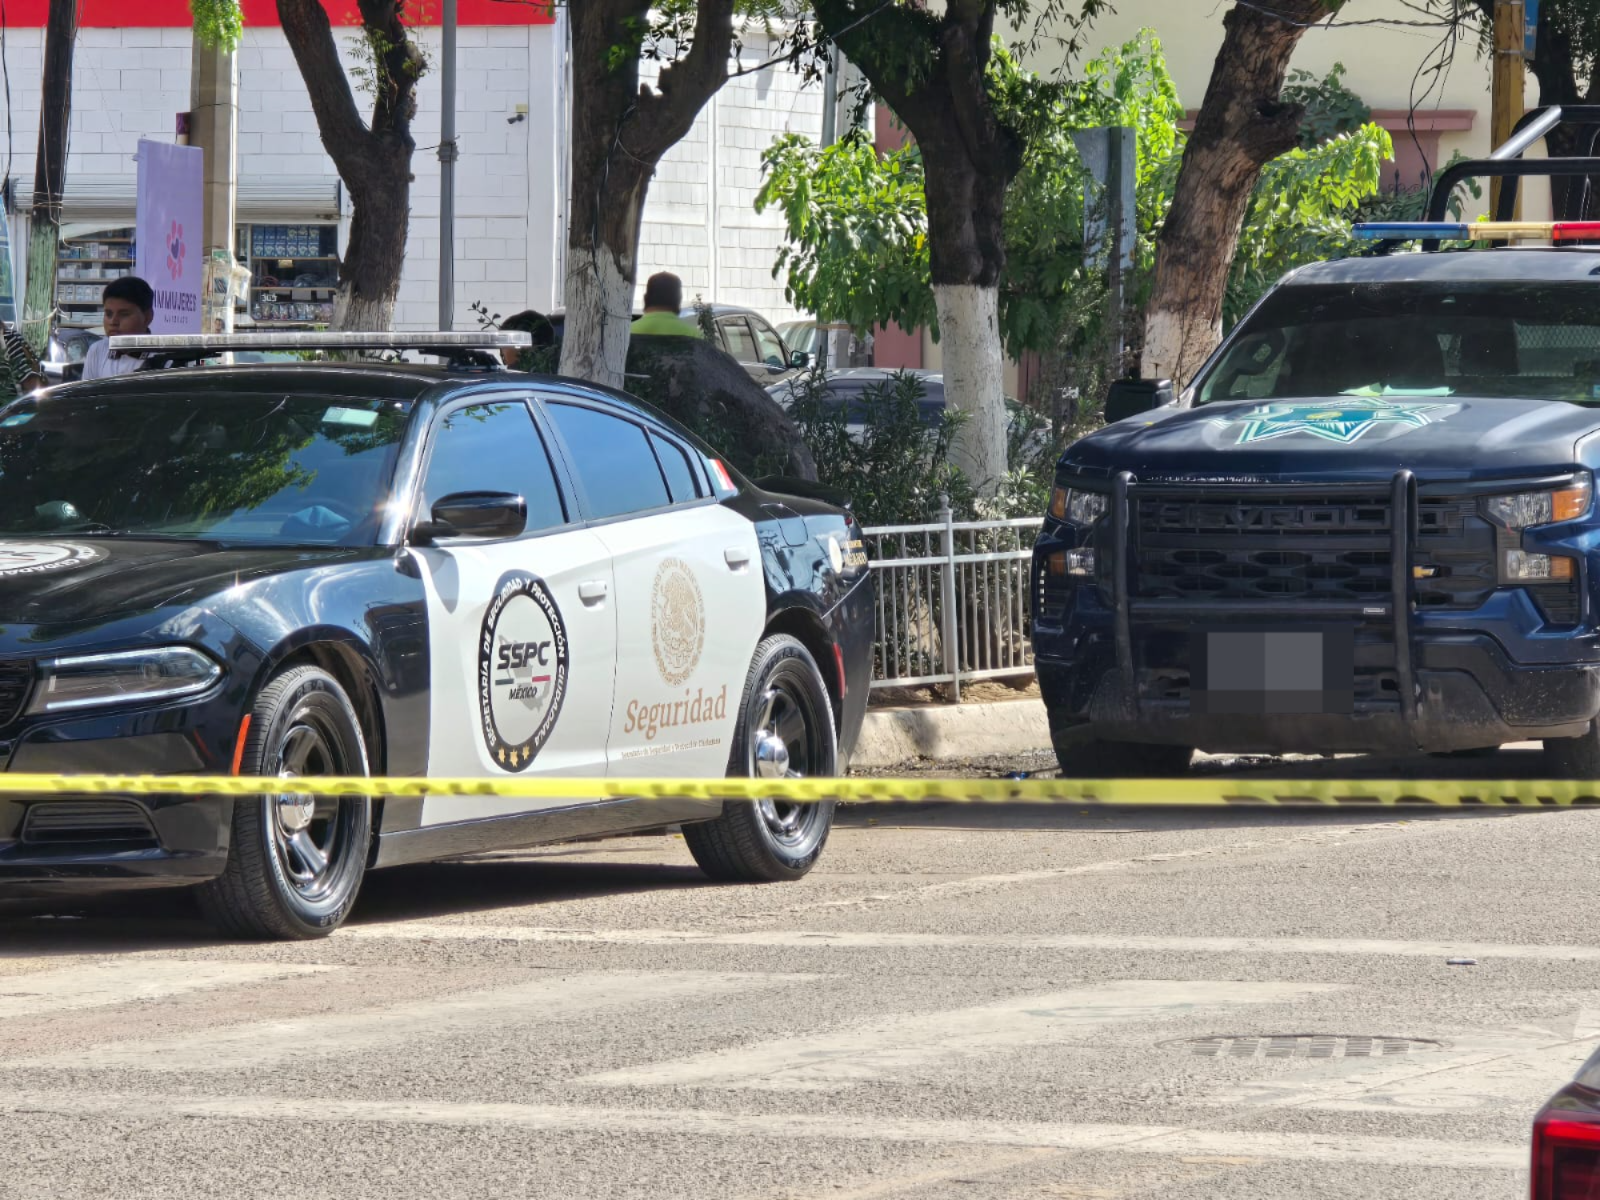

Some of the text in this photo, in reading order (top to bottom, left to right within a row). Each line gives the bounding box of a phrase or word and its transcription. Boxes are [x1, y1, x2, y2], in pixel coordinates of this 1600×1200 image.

[483, 631, 492, 655] DE
[524, 577, 531, 591] Y
[530, 582, 566, 658] PROTECCIÓN
[497, 641, 551, 670] SSPC
[508, 684, 538, 701] MÉXICO
[624, 684, 727, 740] Seguridad
